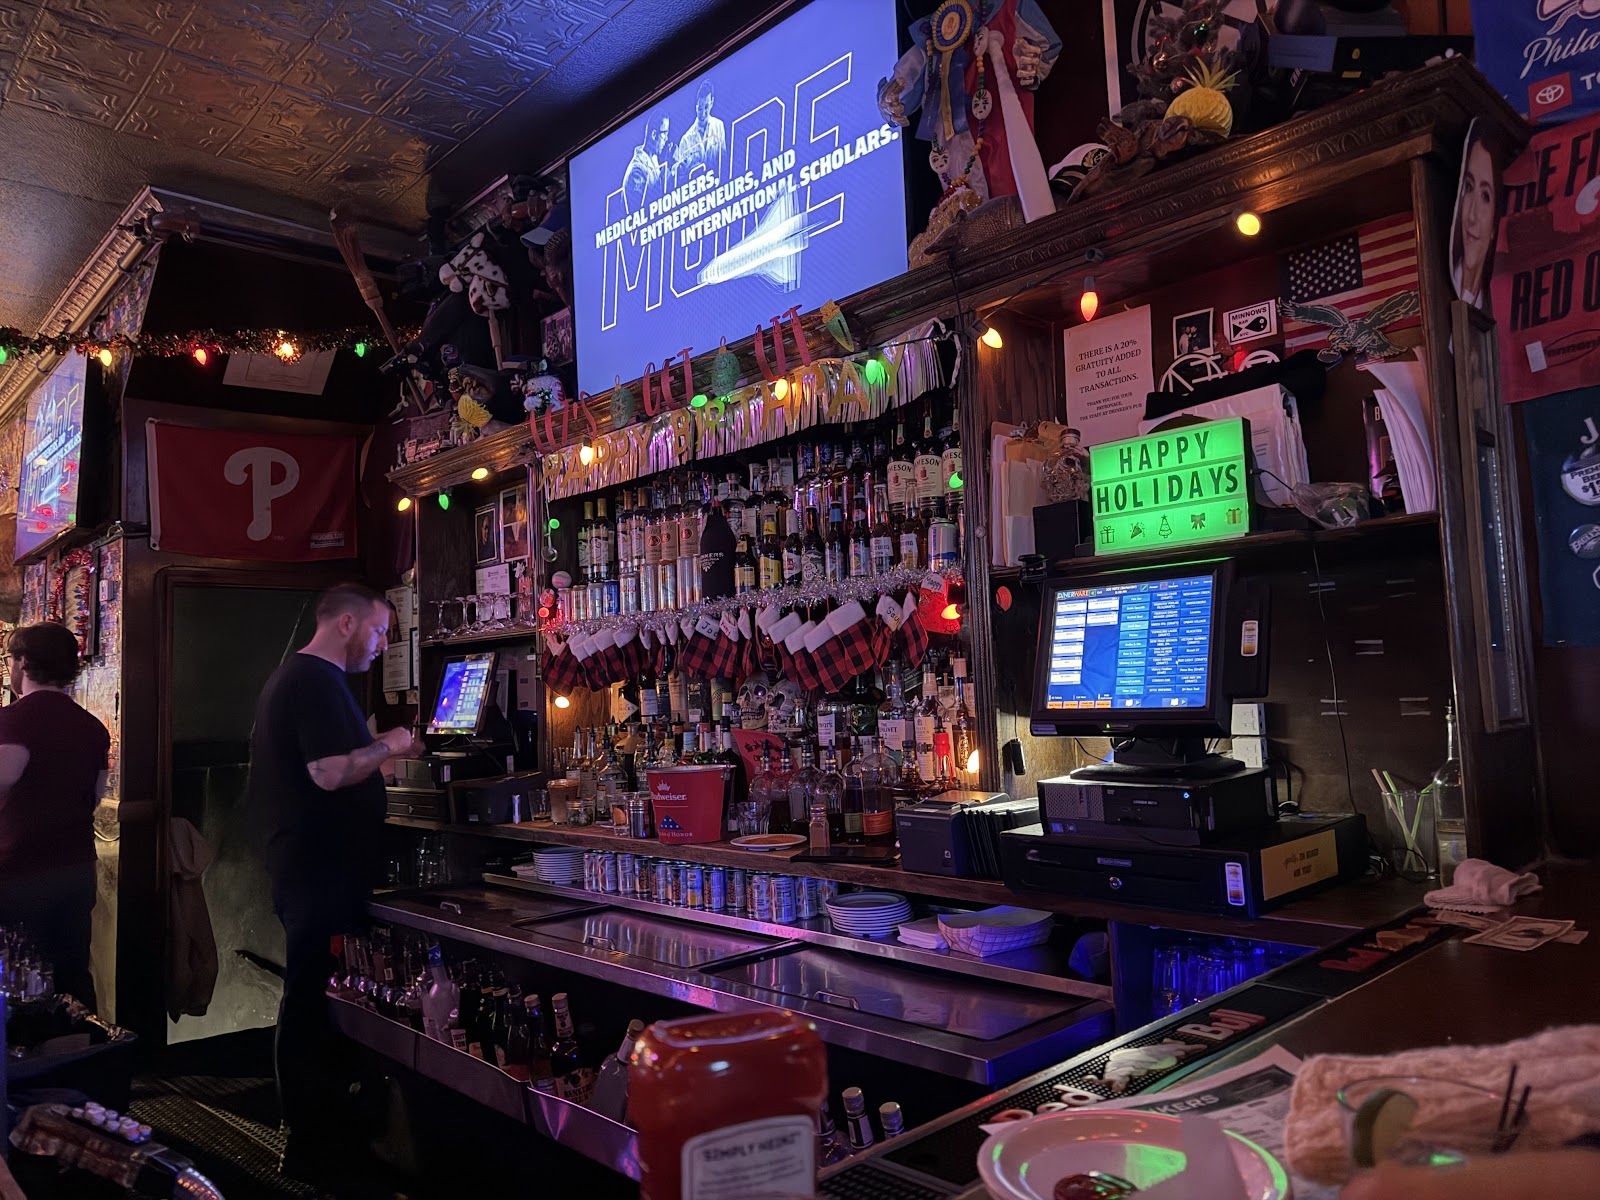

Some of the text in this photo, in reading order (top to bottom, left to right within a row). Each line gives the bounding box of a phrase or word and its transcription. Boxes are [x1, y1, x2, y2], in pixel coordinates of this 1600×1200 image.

[639, 148, 796, 246] ENTREPRENEURS, AND
[680, 125, 899, 247] INTERNATIONAL SCHOLARS.
[595, 170, 720, 249] MEDICAL PIONEERS,
[1231, 307, 1267, 321] MINNOWS
[1510, 259, 1574, 331] RED
[1075, 348, 1142, 373] GRATUITY ADDED
[1078, 338, 1138, 361] THERE IS A 20%
[1095, 365, 1122, 379] TO ALL
[642, 347, 694, 416] GET
[1078, 372, 1139, 394] TRANSACTIONS.
[1086, 398, 1103, 407] THANK
[537, 421, 654, 493] HAPPY
[1119, 430, 1210, 475] HAPPY
[1096, 463, 1239, 514] HOLIDAYS
[1175, 1008, 1266, 1042] Bull
